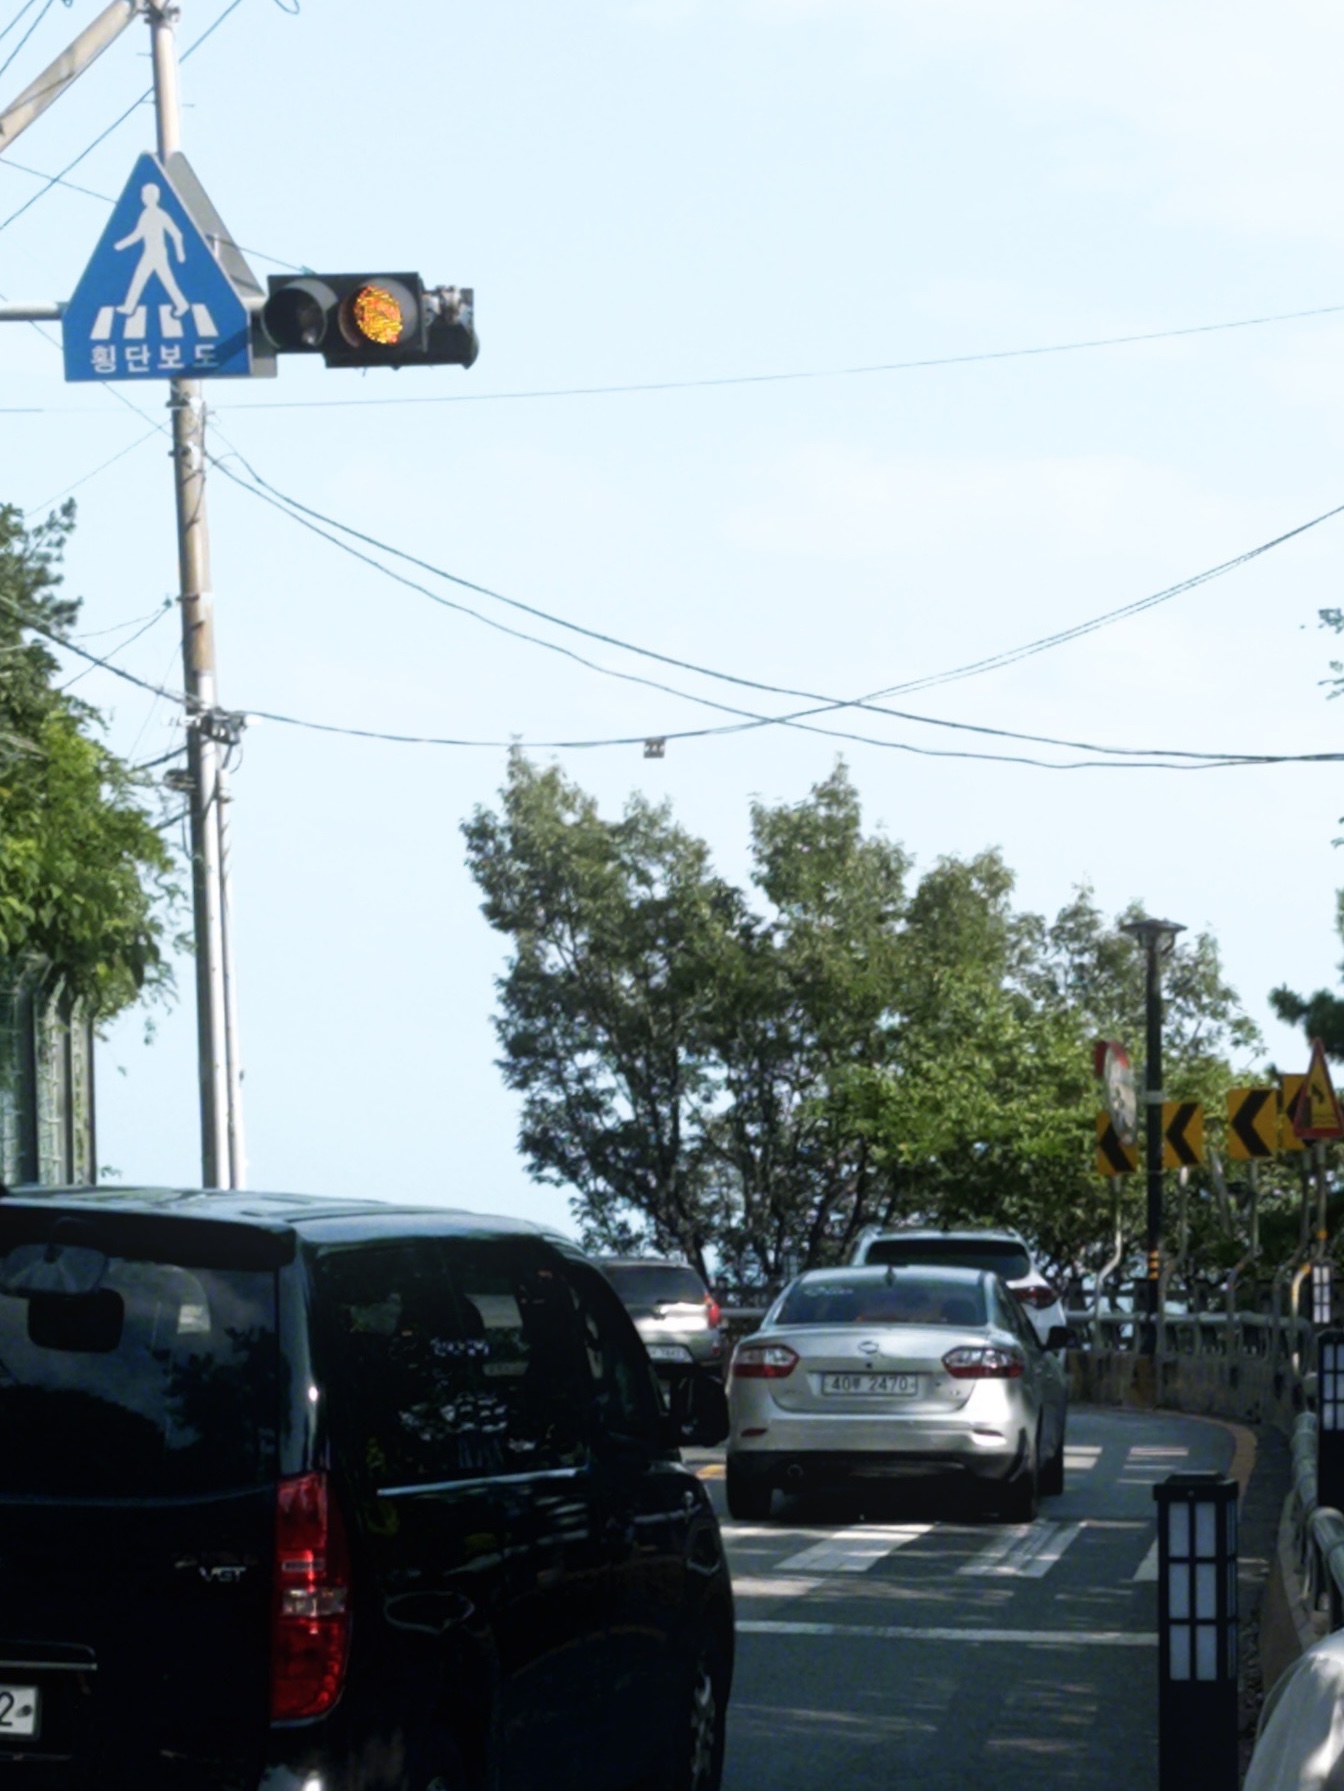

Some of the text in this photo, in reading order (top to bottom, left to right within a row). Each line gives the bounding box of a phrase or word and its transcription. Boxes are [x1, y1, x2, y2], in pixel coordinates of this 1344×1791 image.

[91, 344, 219, 373] 횡단보도
[869, 1374, 909, 1391] 2470
[199, 1566, 247, 1583] VGT
